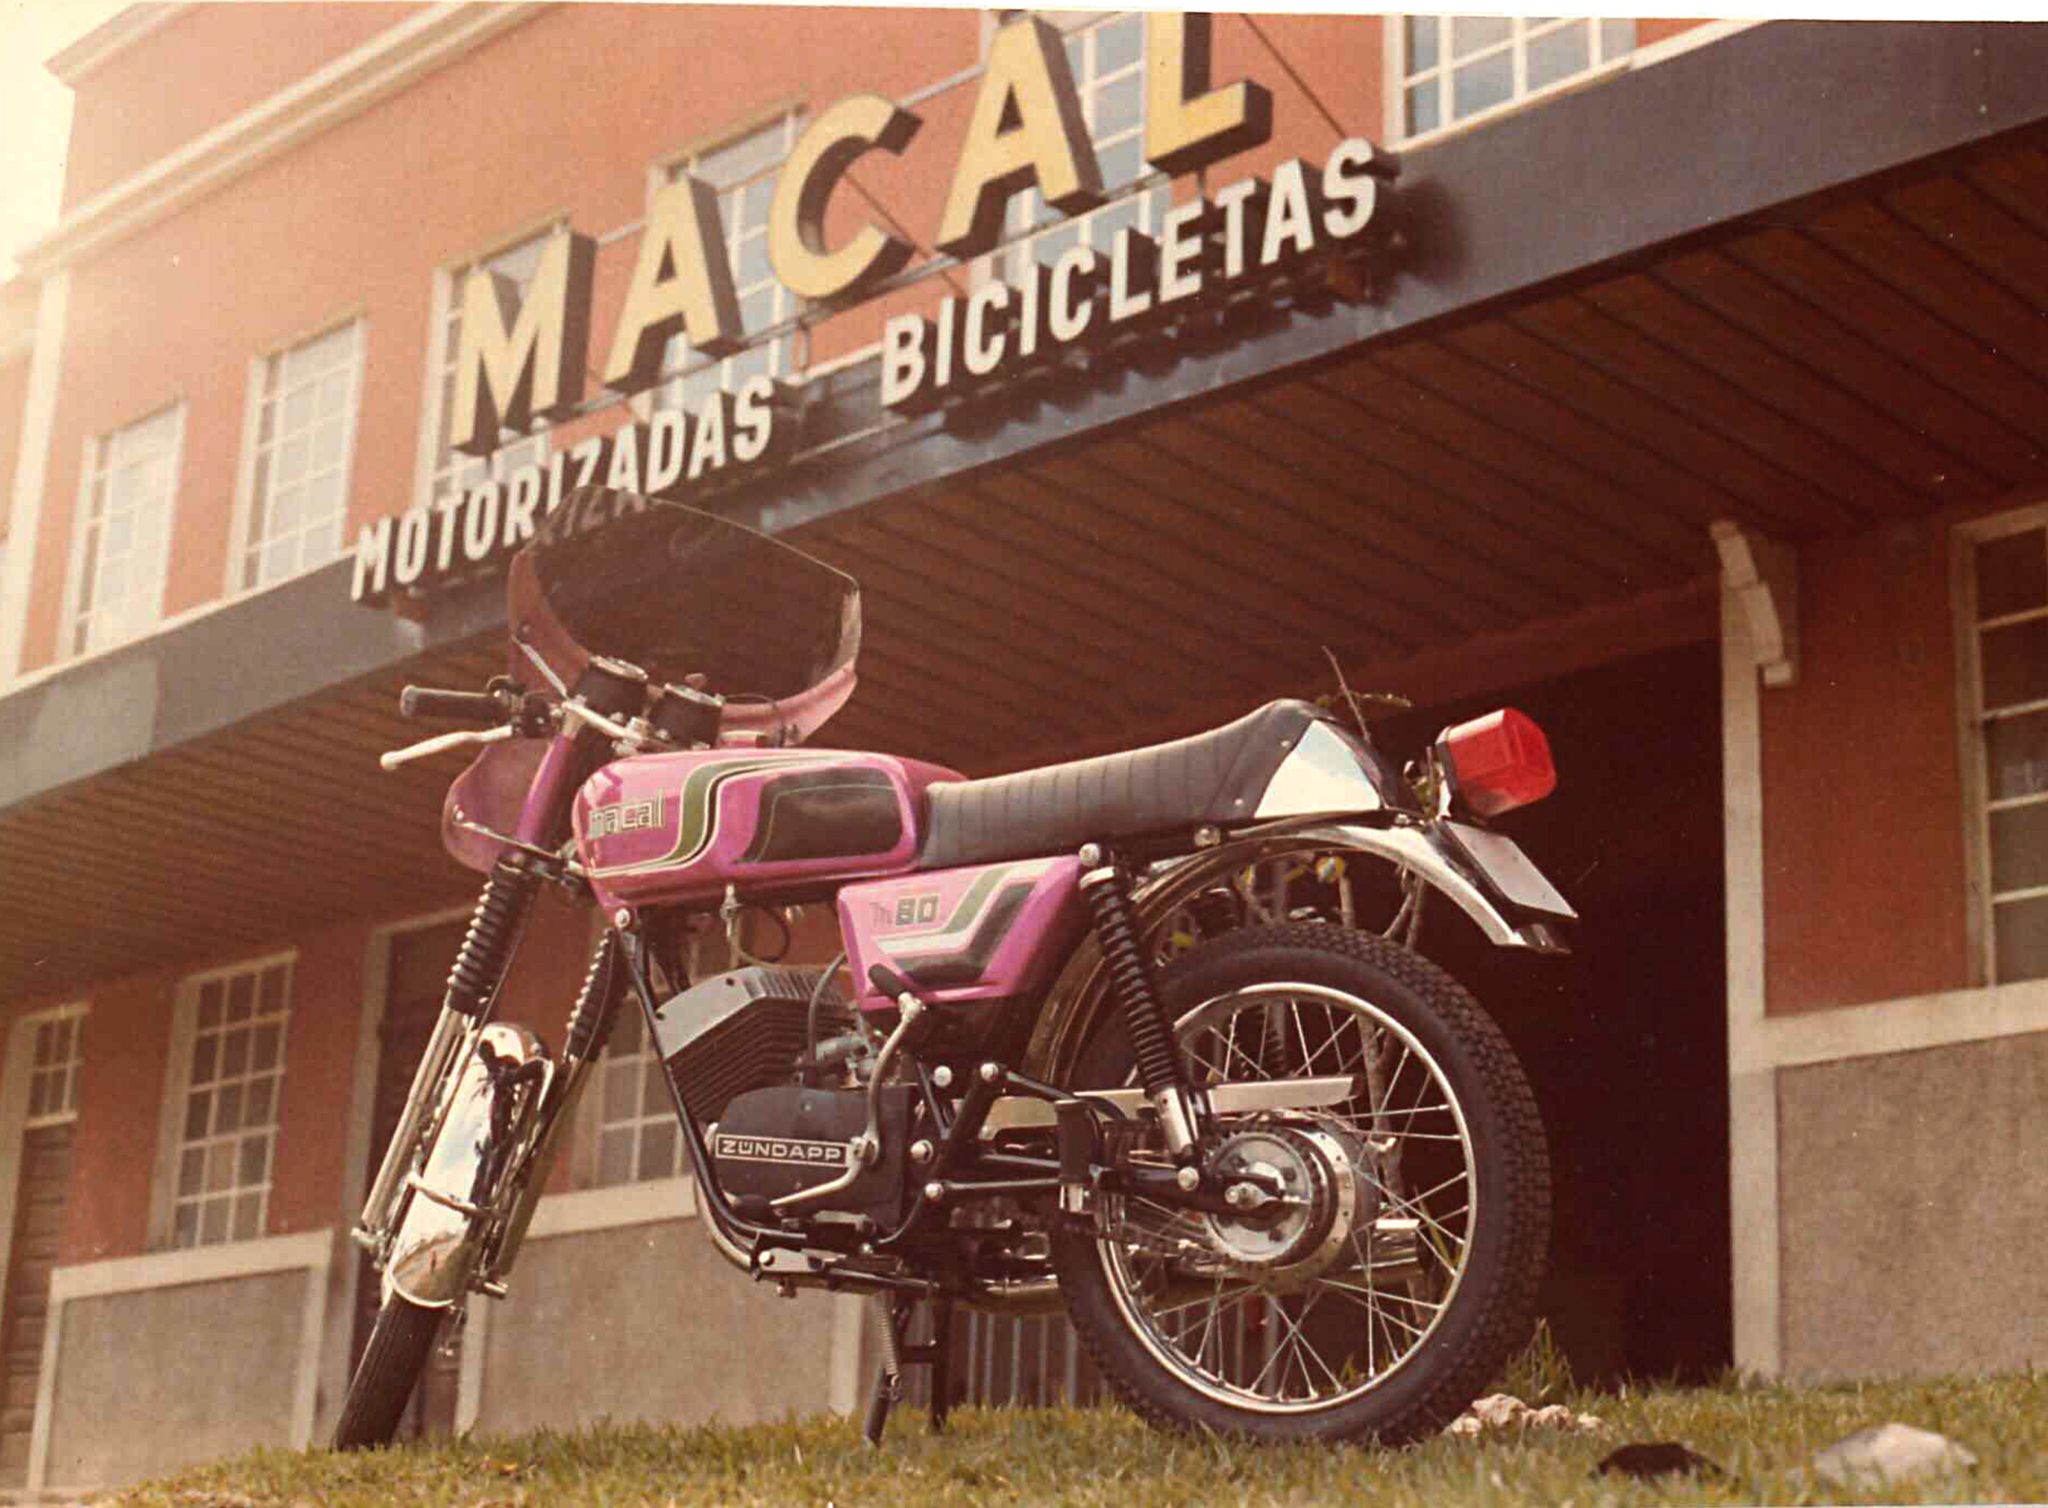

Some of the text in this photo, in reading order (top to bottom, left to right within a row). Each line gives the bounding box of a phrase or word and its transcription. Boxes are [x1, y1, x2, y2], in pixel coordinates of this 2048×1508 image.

[350, 137, 1378, 602] MOTORIZADAS BICICLETAS
[449, 11, 1268, 447] MACAL
[721, 1139, 842, 1162] ZÜNDAPP
